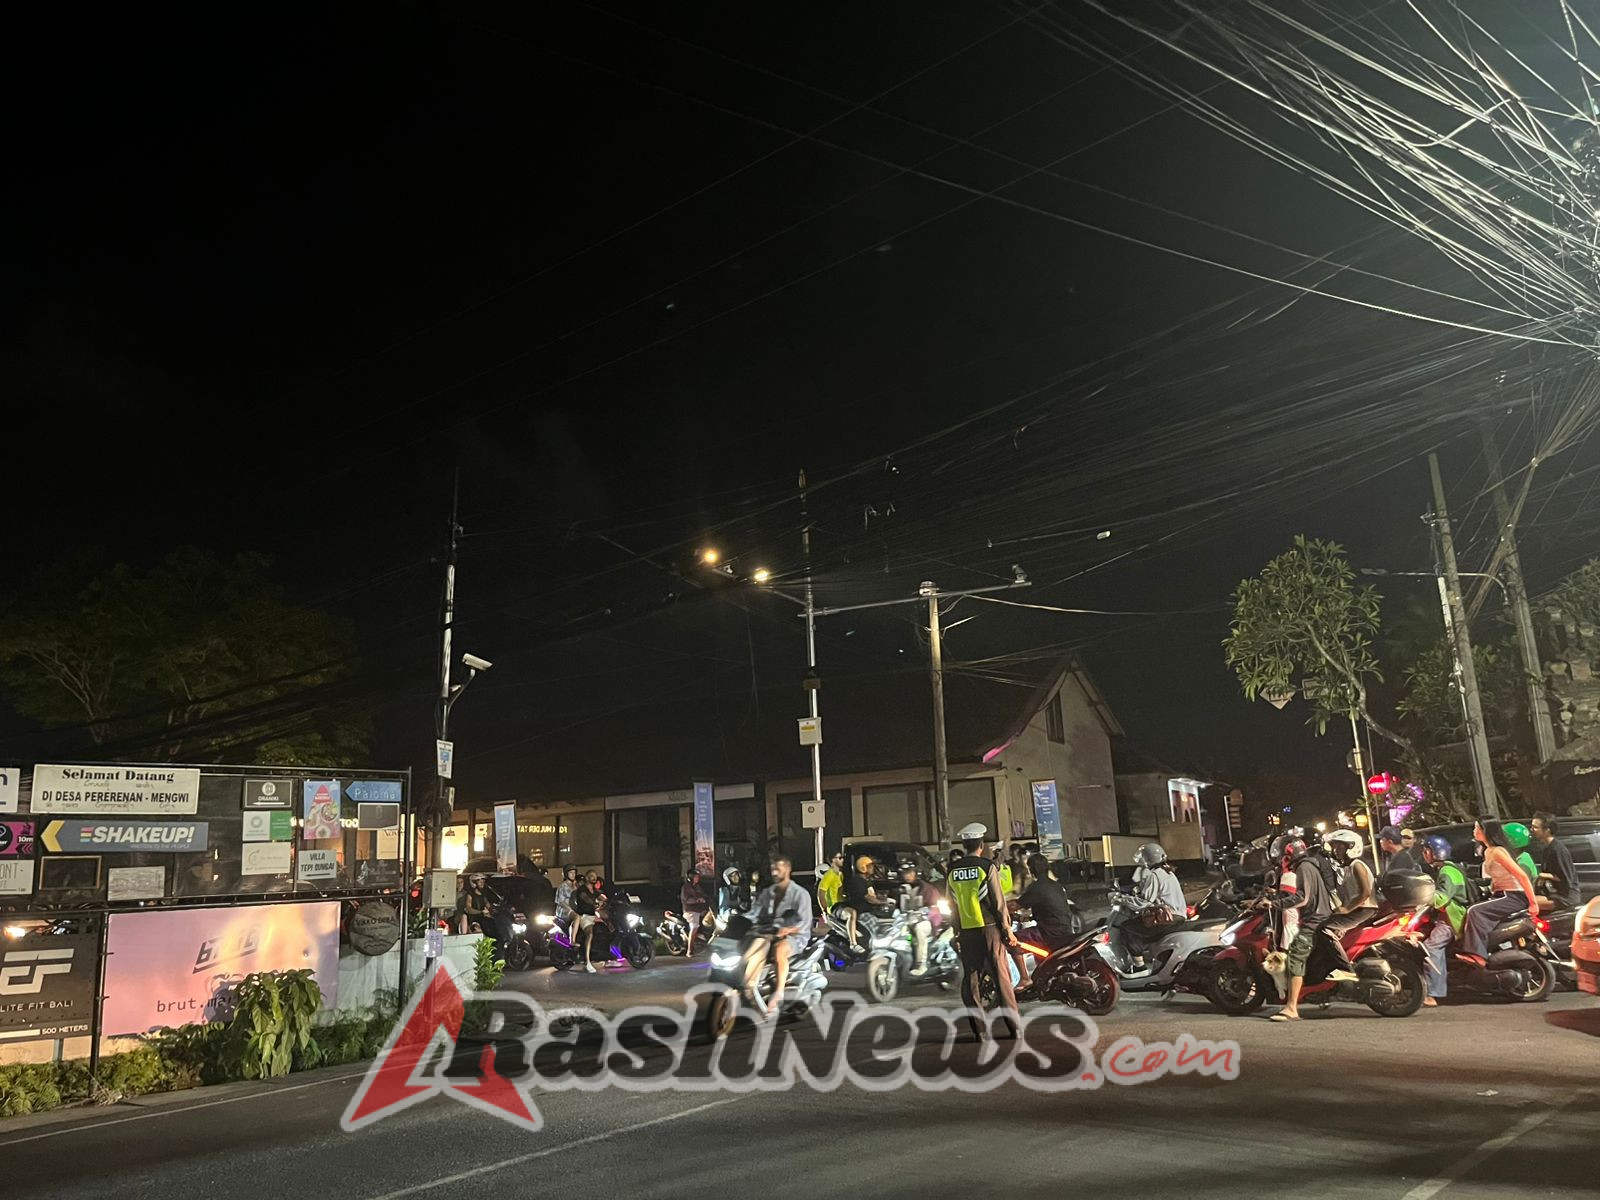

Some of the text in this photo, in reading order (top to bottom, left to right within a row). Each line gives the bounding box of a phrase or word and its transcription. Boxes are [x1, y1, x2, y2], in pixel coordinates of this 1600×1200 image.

[62, 767, 175, 784] Selamat Datang
[42, 790, 52, 801] DI
[56, 791, 82, 802] DESA
[84, 791, 143, 803] PERERENAN
[151, 792, 189, 803] MENGWI
[354, 787, 396, 799] Paloma
[92, 826, 196, 843] SHAKEUP!
[310, 852, 326, 861] VILLA
[953, 868, 979, 881] POLISI
[28, 1001, 46, 1010] FIT
[49, 999, 74, 1009] BALI
[42, 1024, 89, 1035] 500 METERS
